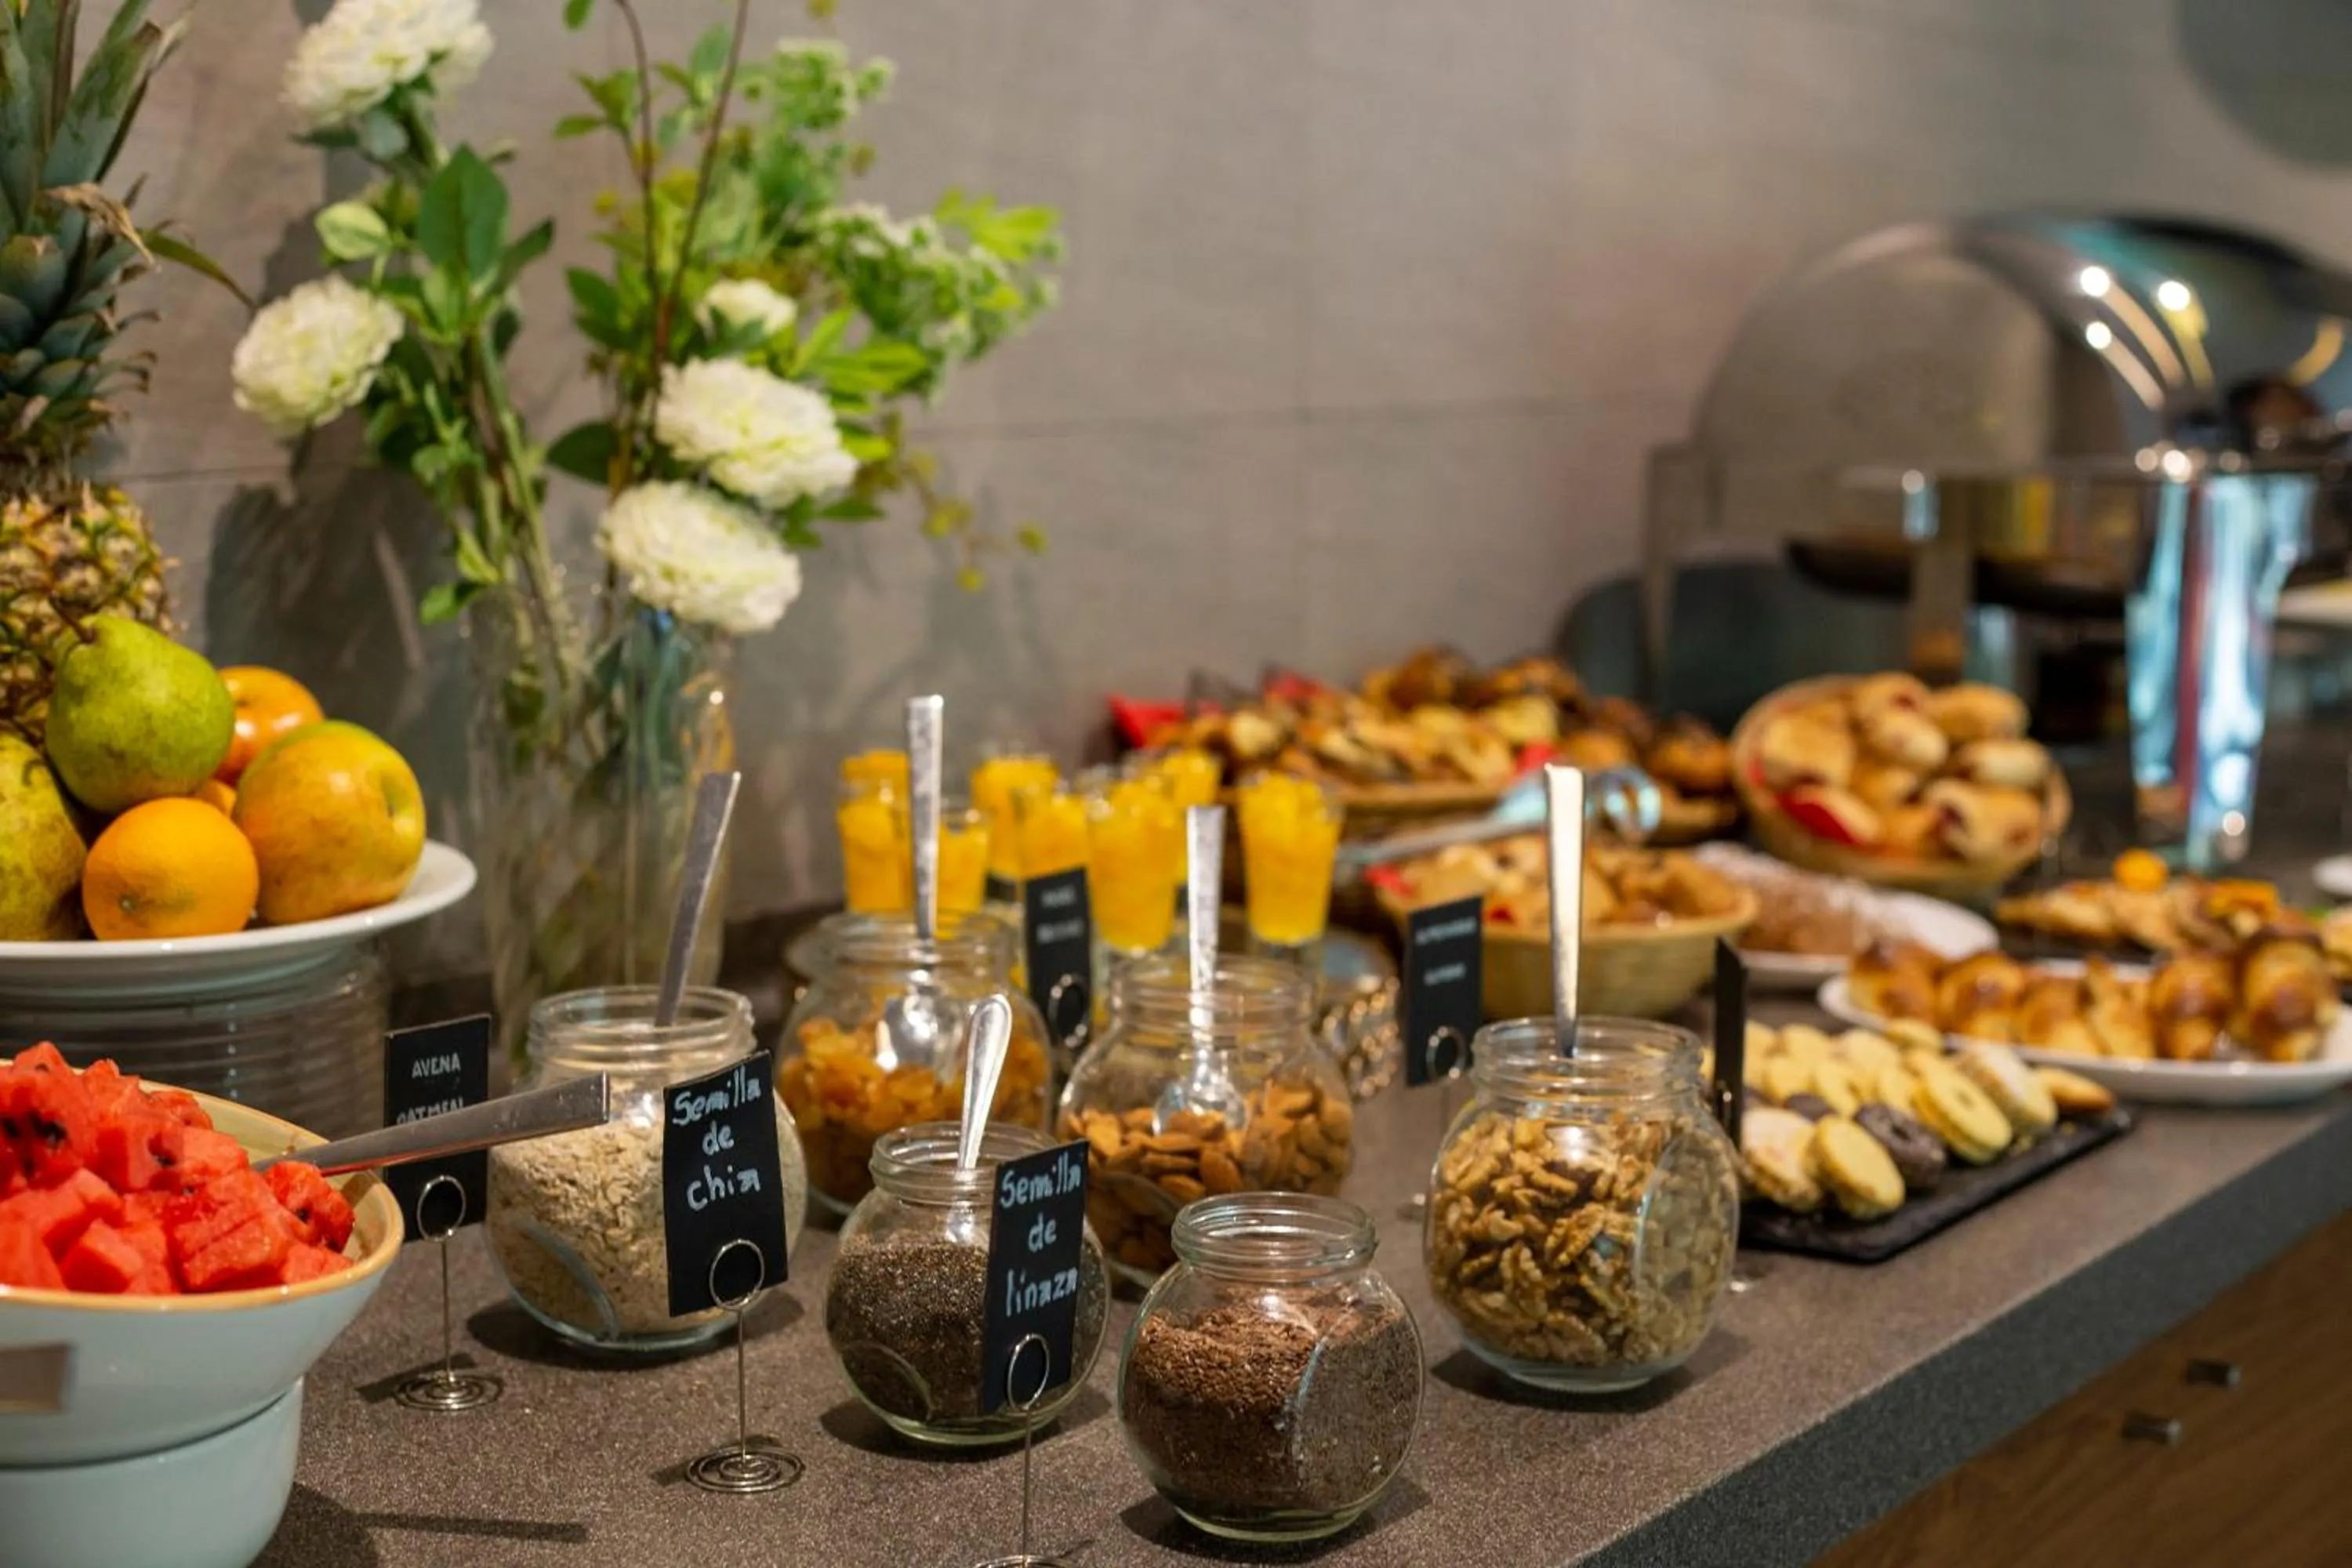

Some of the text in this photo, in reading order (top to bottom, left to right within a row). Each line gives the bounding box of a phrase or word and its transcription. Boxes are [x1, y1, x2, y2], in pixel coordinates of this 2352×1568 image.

[412, 1053, 461, 1079] AVENA
[673, 1065, 762, 1126] Semilla
[702, 1121, 735, 1156] de
[687, 1165, 760, 1210] chia
[1000, 1152, 1082, 1208] Semilla
[1028, 1212, 1057, 1253] de
[1006, 1266, 1079, 1317] linaza
